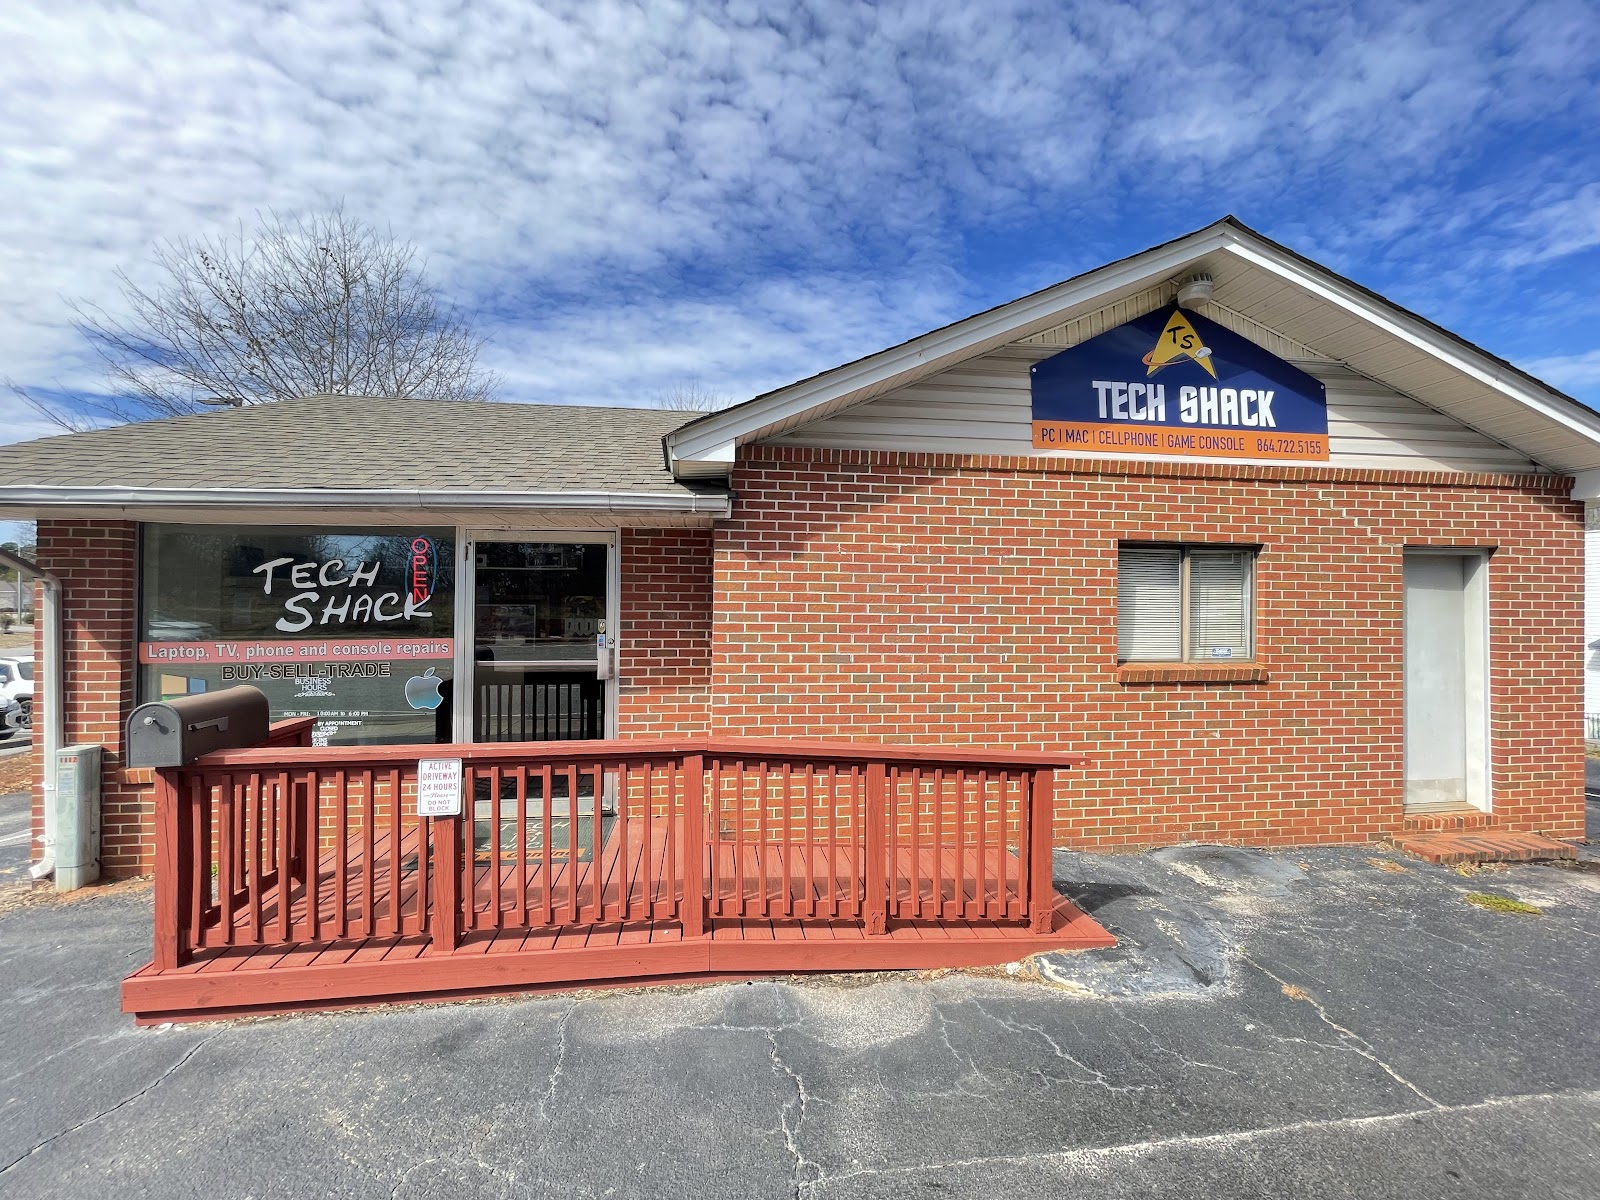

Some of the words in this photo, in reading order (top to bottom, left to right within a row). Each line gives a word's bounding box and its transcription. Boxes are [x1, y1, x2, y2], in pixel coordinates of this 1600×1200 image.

[1092, 380, 1166, 422] TECH
[1179, 385, 1277, 428] SHACK
[1041, 427, 1056, 442] PC
[1065, 429, 1089, 444] MAC
[1098, 430, 1158, 447] CELLPHONE
[1167, 433, 1196, 449] GAME
[1198, 435, 1245, 451] CONSOLE
[1257, 438, 1321, 455] 864.722.5155
[253, 557, 380, 595] TECH
[411, 537, 429, 605] OPEN
[275, 591, 433, 632] SHACK
[148, 644, 210, 660] Laptop,
[215, 643, 241, 660] TV,
[246, 643, 294, 660] phone
[300, 642, 327, 656] and
[332, 641, 392, 655] console
[397, 640, 449, 657] repairs
[423, 772, 457, 780] DRIVEWAY
[429, 762, 452, 770] ACTIVE
[423, 783, 431, 791] 24
[434, 783, 457, 791] HOURS
